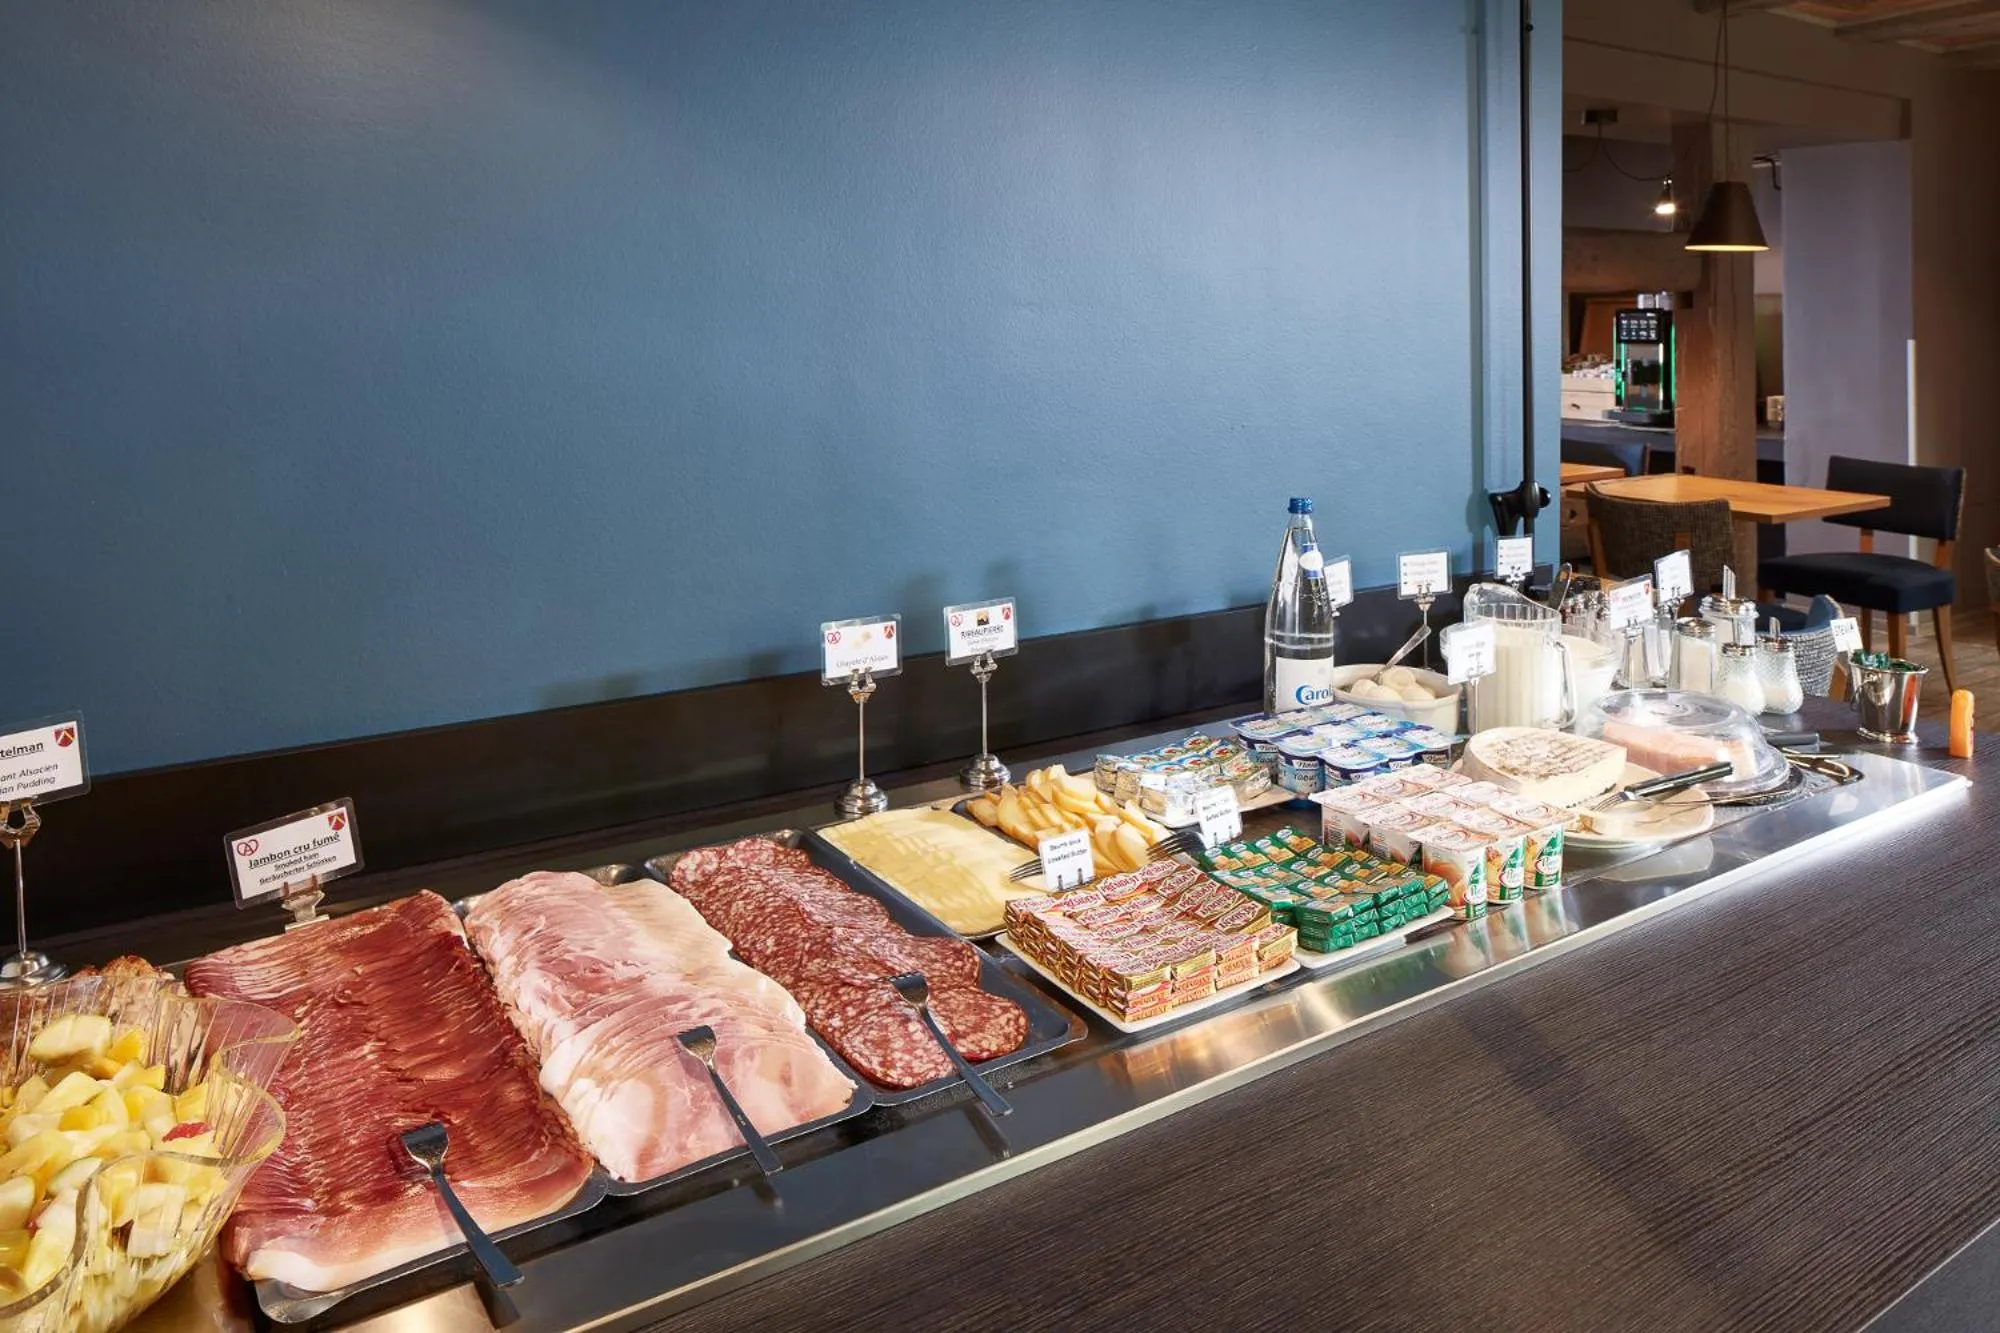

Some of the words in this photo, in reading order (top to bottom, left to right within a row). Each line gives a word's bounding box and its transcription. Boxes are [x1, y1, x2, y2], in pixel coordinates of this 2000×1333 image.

[1295, 684, 1333, 706] Carol
[0, 742, 44, 758] telman
[19, 763, 58, 778] Alsacien
[17, 776, 56, 792] Pudding
[248, 848, 291, 870] Jambon
[293, 843, 311, 854] cru
[312, 832, 341, 849] fumé
[274, 857, 301, 872] Smoked
[302, 851, 320, 862] ham
